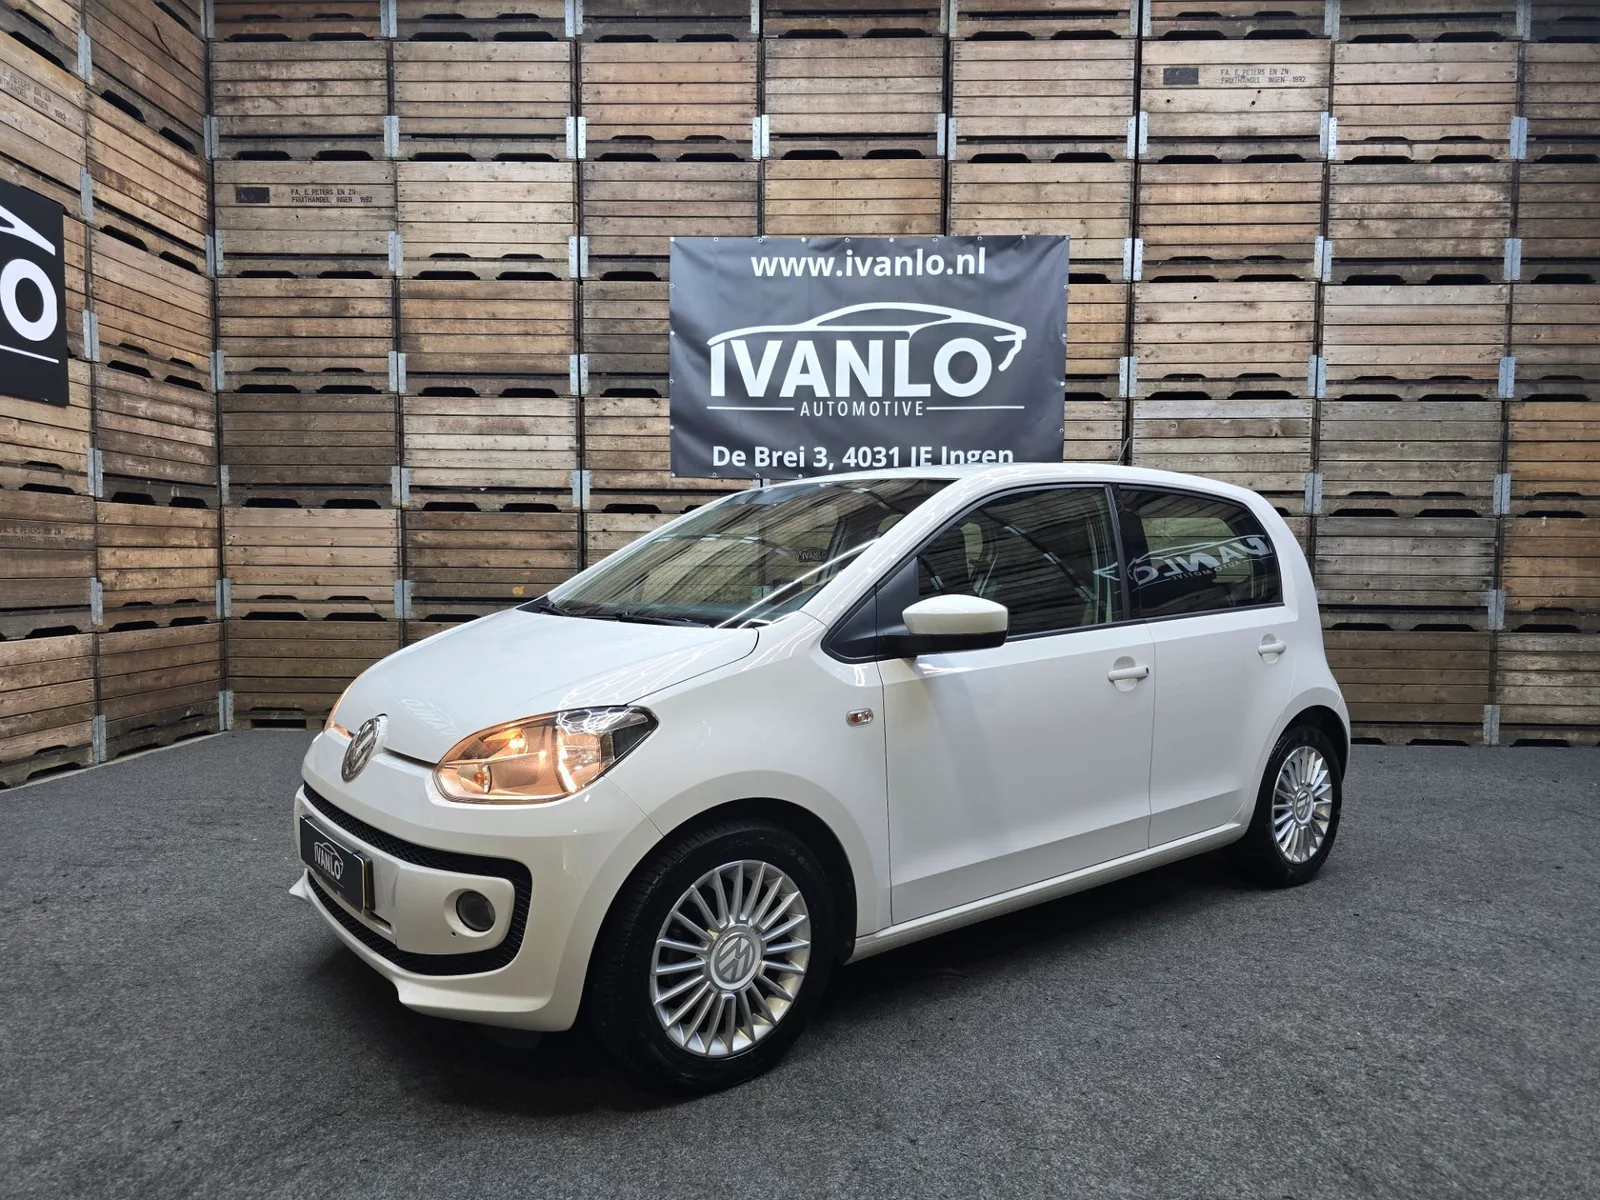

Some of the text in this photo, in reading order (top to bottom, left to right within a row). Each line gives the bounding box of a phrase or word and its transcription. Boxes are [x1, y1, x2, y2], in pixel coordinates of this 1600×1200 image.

[1269, 68, 1278, 76] EN
[751, 247, 986, 277] www.ivanlo.nl
[710, 337, 993, 398] IVANLO
[800, 401, 924, 418] AUTOMOTIVE
[712, 446, 747, 468] De
[754, 446, 806, 468] Brei
[812, 446, 835, 471] 3,
[842, 446, 900, 468] 4031
[941, 446, 1014, 466] Ingen
[314, 844, 341, 880] IVANLO
